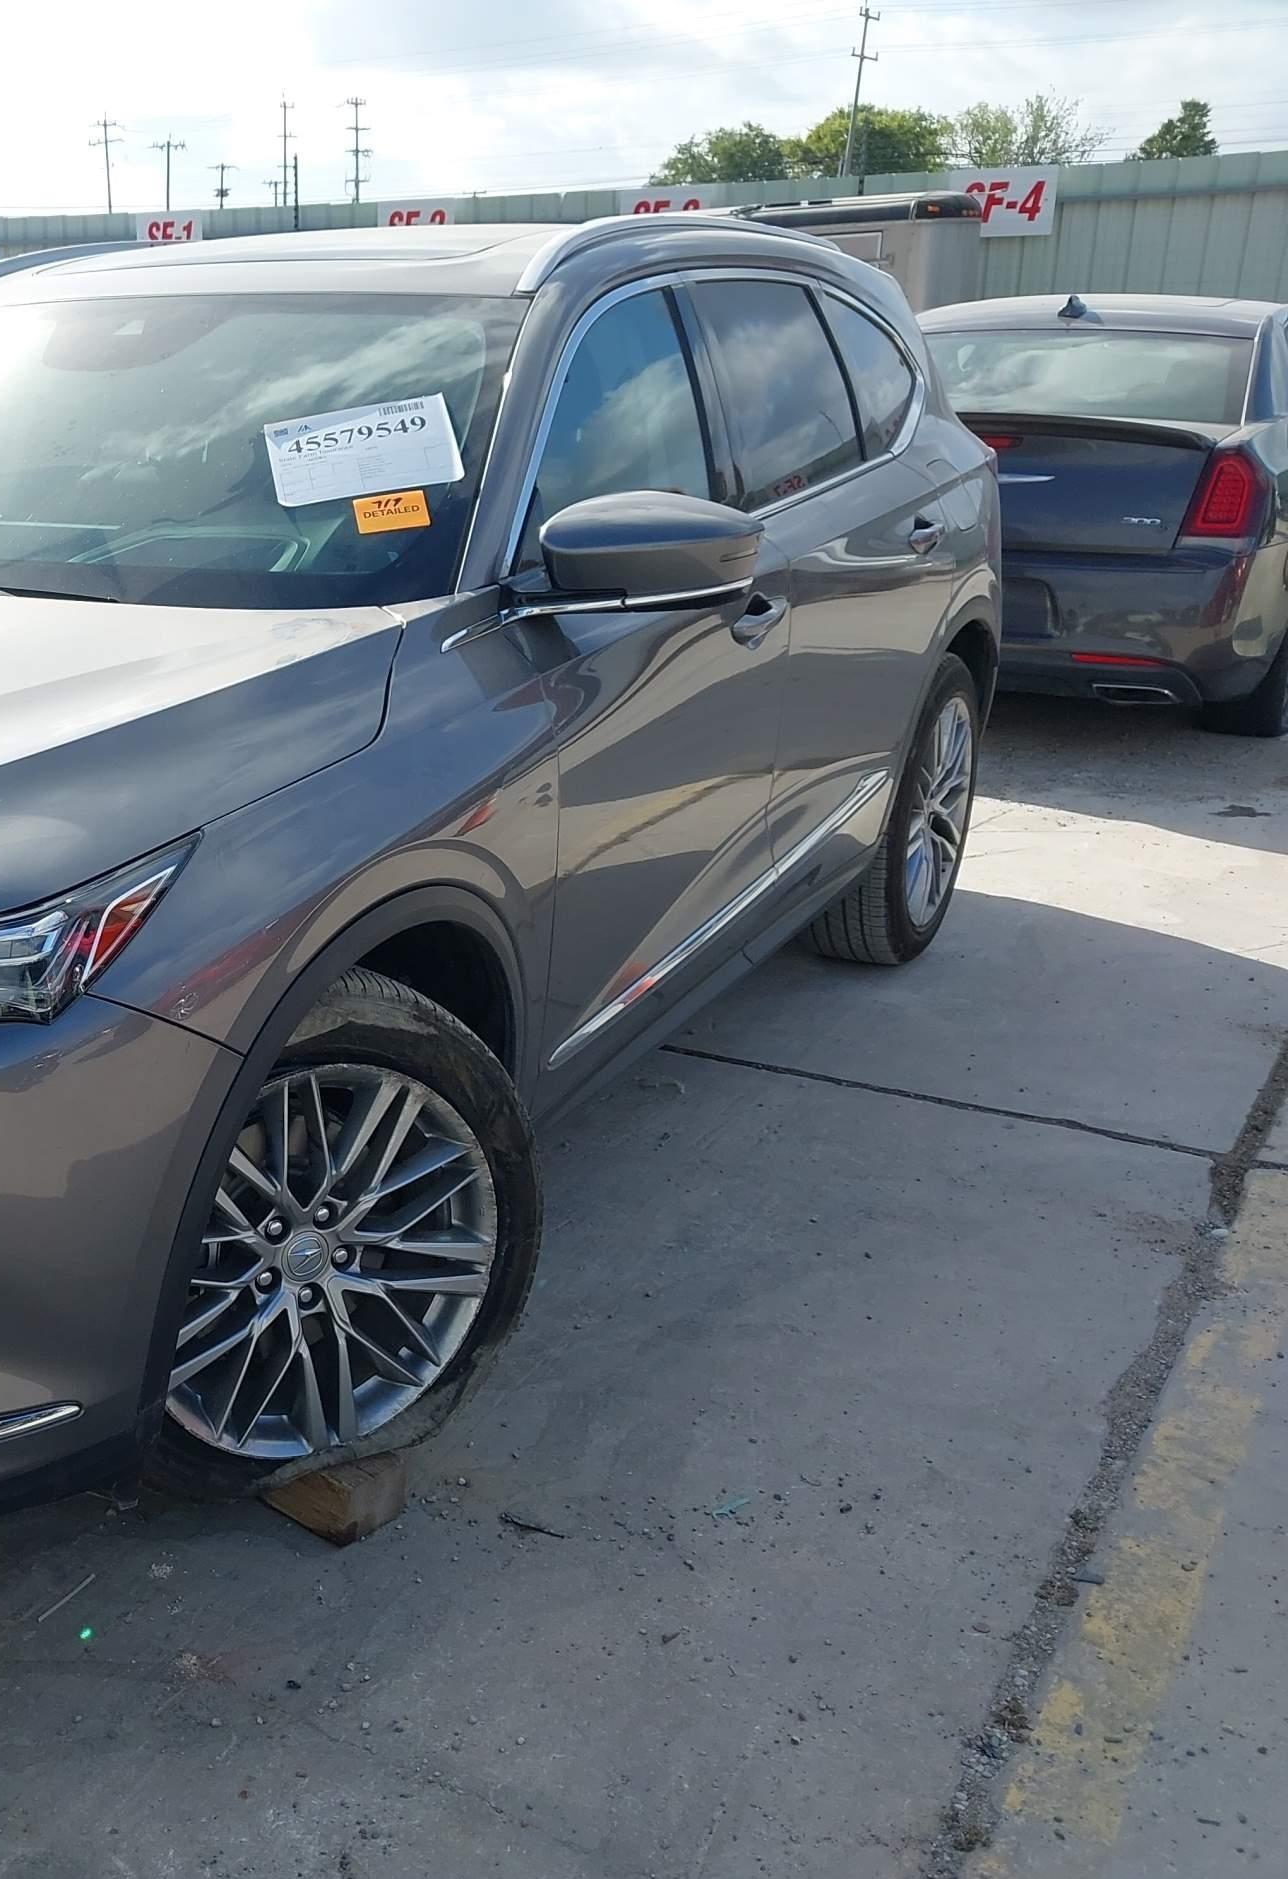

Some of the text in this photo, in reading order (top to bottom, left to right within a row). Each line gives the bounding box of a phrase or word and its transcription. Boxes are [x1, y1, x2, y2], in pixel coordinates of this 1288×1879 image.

[966, 181, 1046, 223] F-4
[288, 416, 426, 453] 45579549
[363, 504, 420, 519] DETAILED
